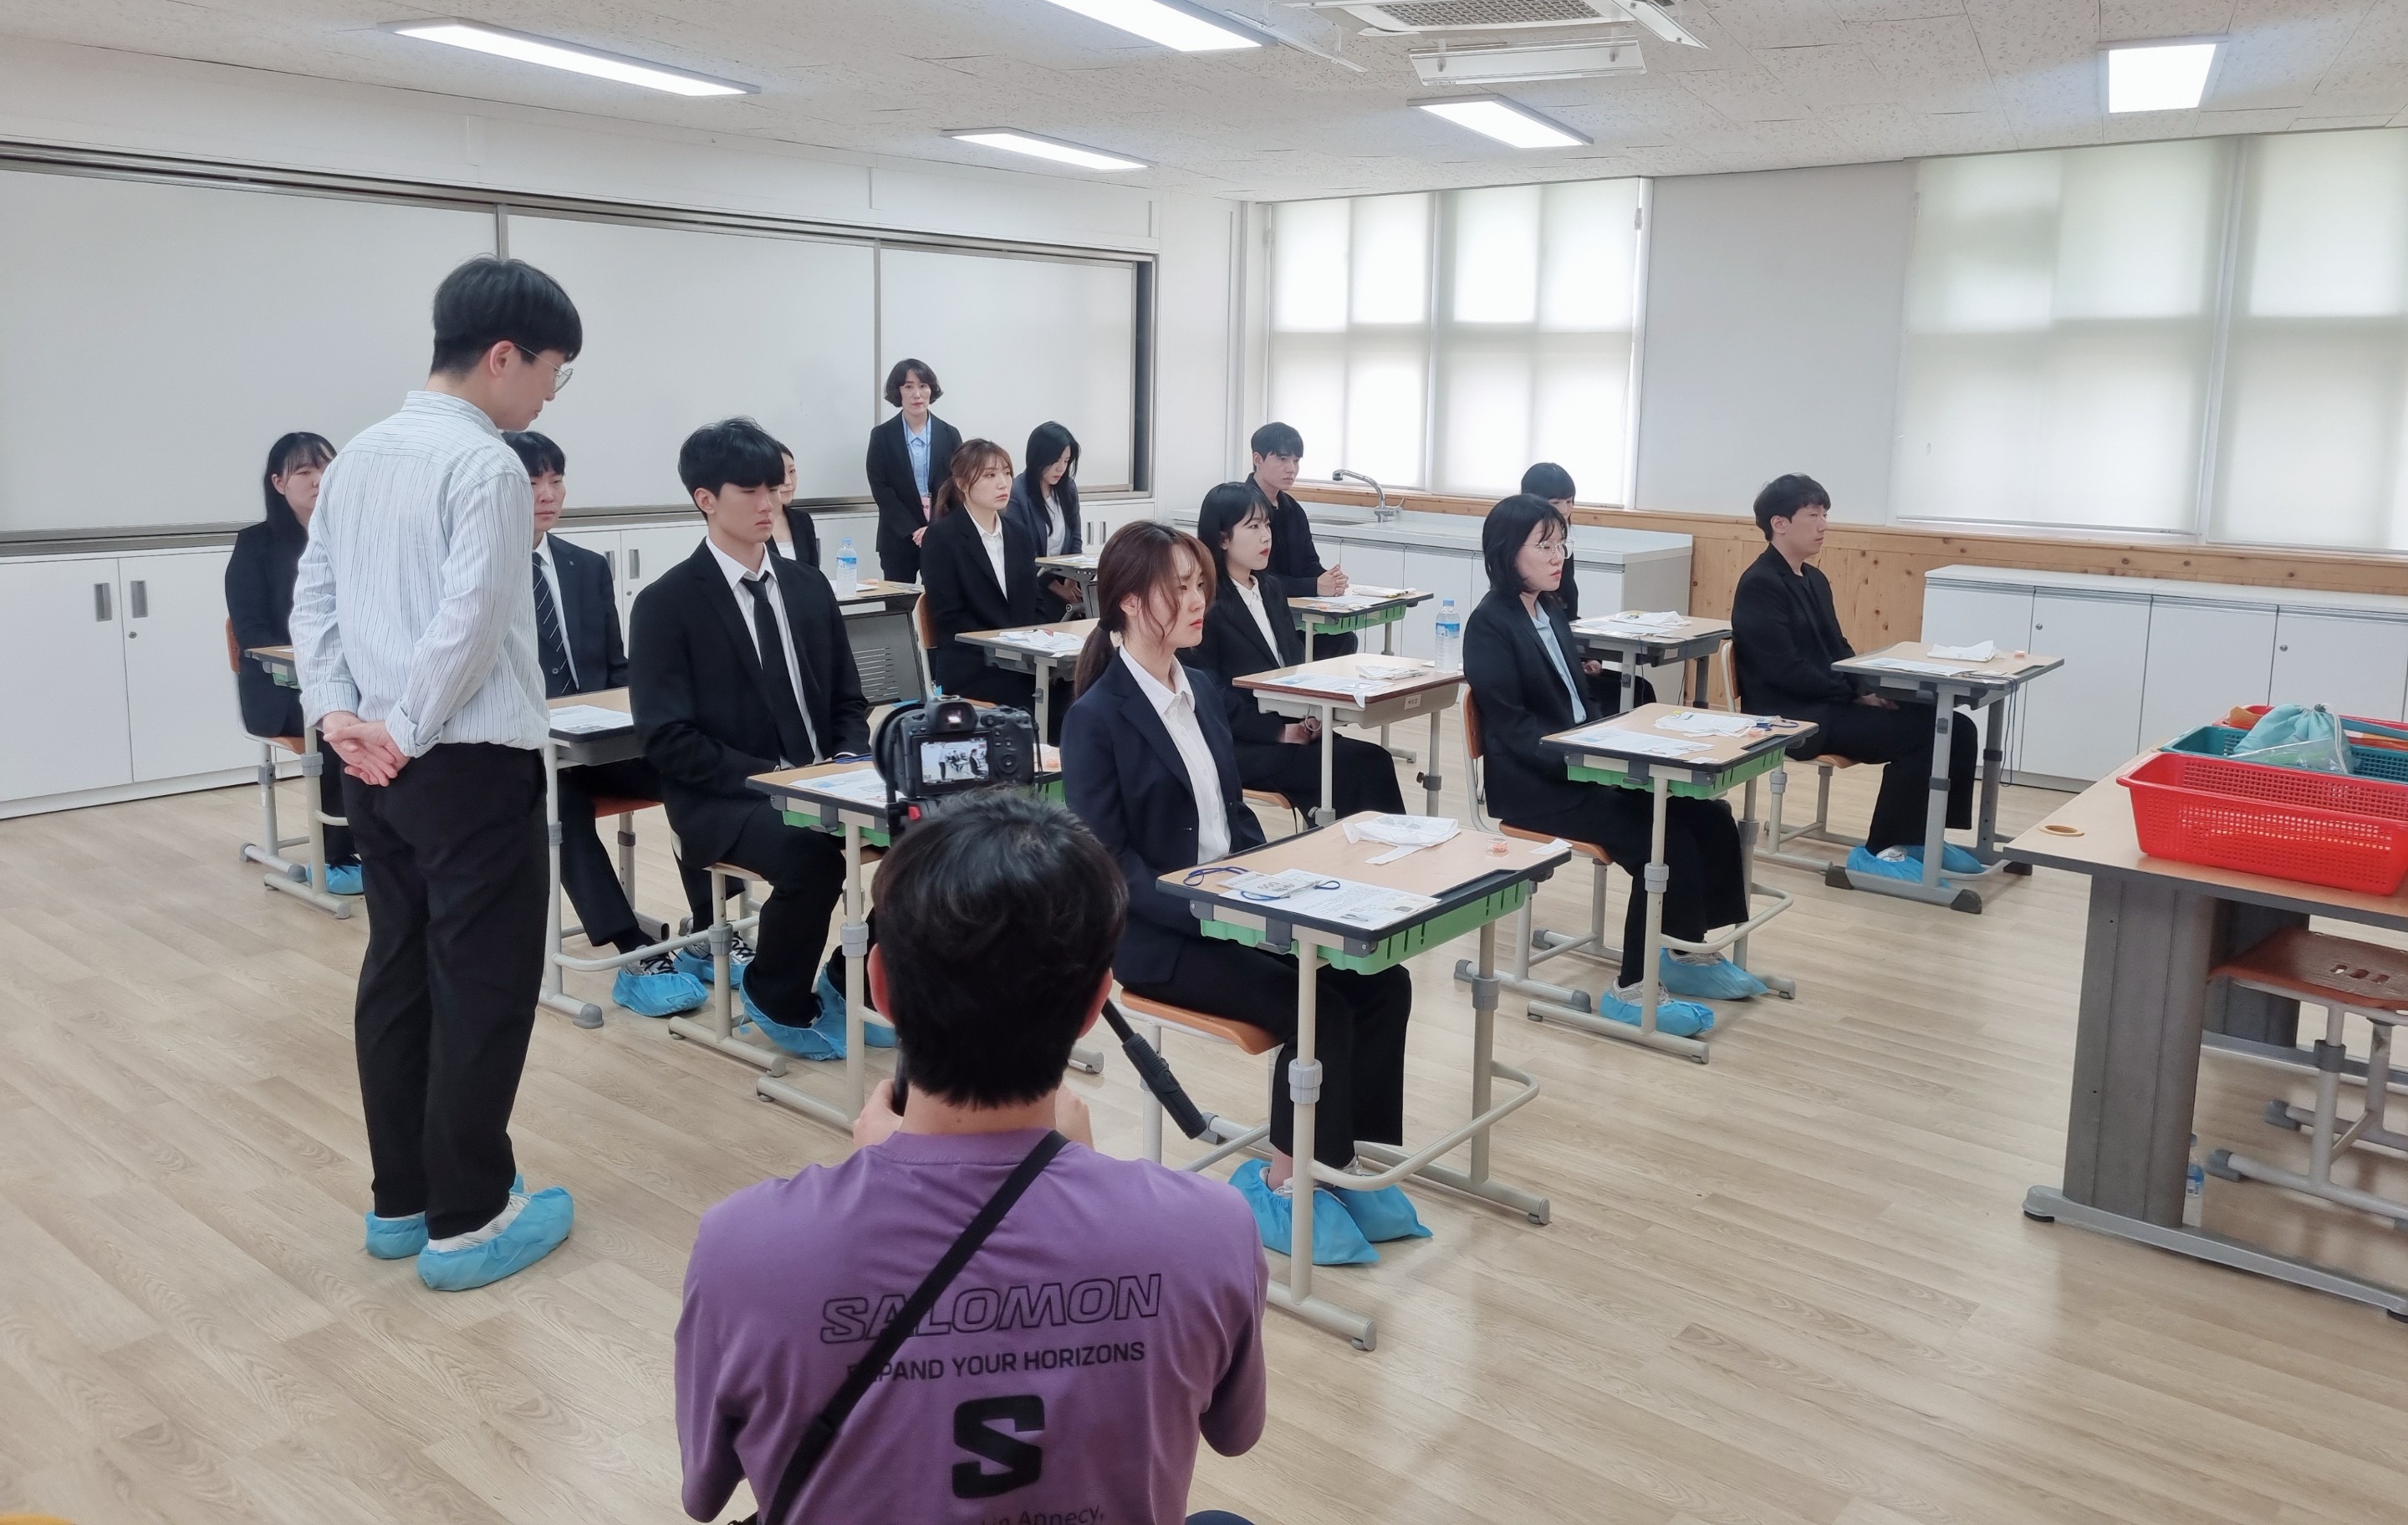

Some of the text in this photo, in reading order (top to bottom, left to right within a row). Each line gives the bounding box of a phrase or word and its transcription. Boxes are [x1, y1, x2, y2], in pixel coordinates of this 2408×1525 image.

[820, 1273, 1161, 1344] SALOMON
[848, 1341, 1146, 1385] PAND YOUR HORIZONS
[951, 1394, 1046, 1499] S
